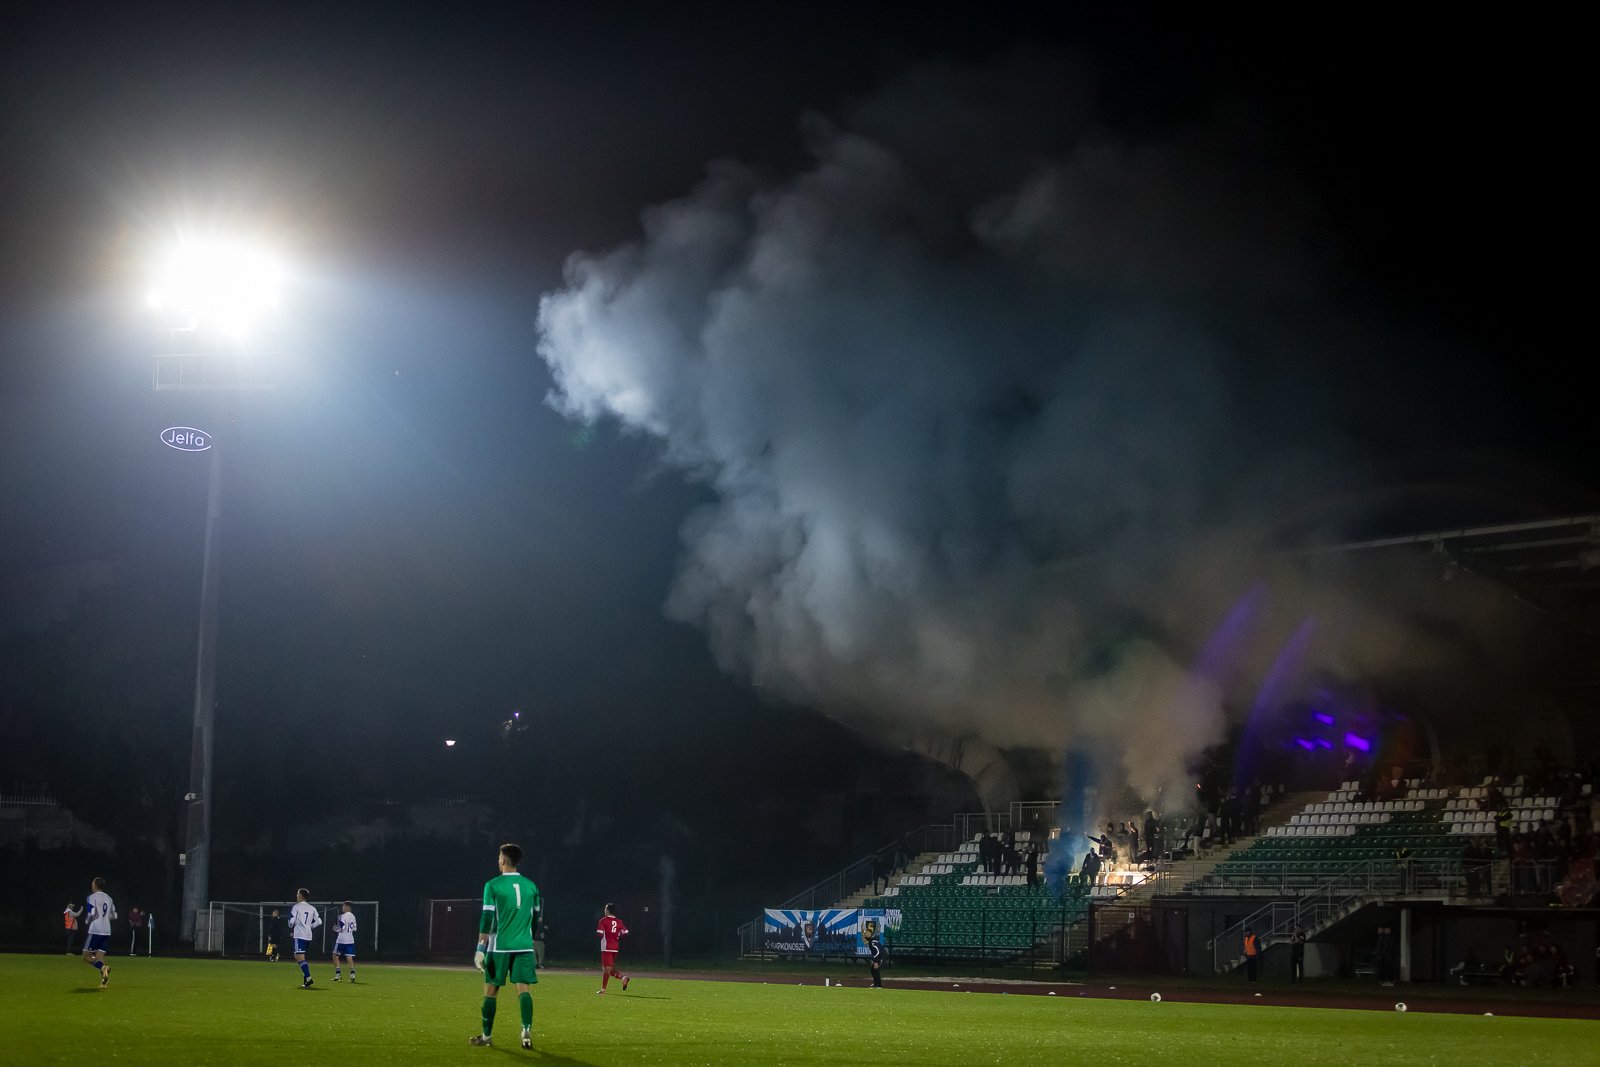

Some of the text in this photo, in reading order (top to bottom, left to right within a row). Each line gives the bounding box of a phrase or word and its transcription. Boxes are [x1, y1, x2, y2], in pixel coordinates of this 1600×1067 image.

[168, 430, 205, 447] Jelfa
[512, 883, 521, 909] 1
[102, 902, 108, 918] 9
[304, 911, 309, 925] 7
[611, 920, 618, 933] 2
